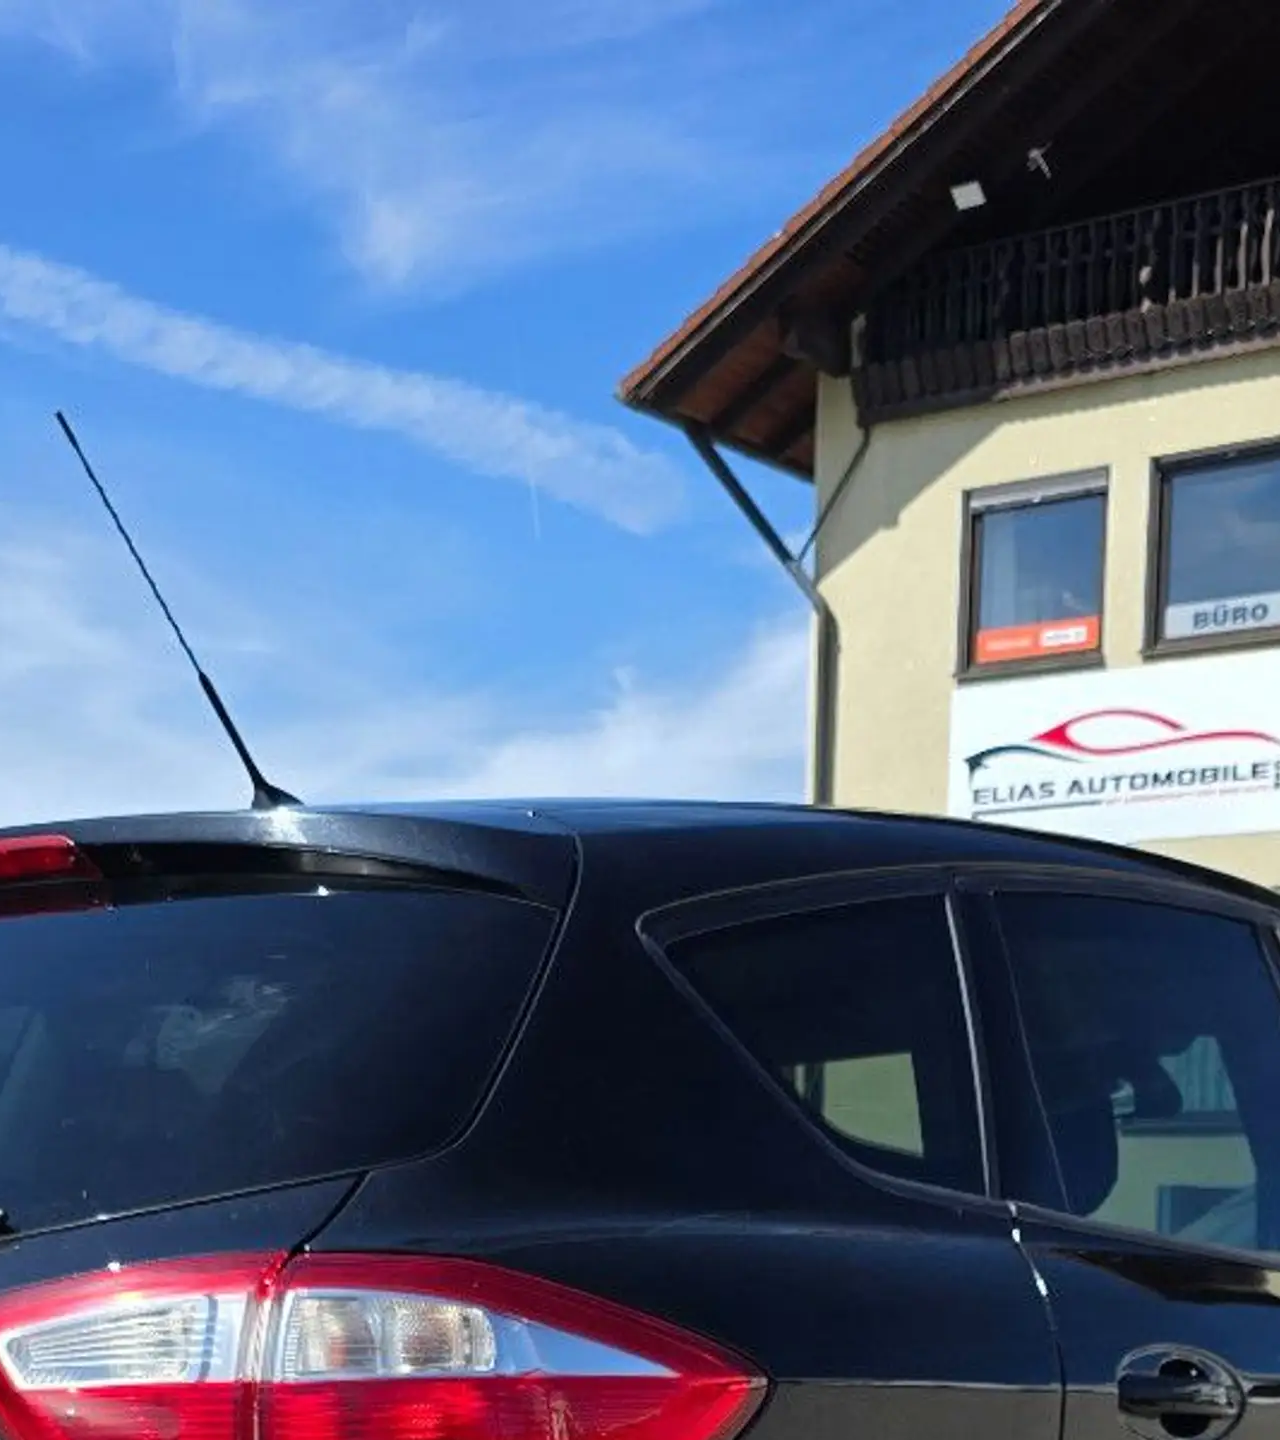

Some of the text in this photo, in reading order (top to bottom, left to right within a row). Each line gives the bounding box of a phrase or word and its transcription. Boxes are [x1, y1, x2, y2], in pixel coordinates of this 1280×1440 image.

[1193, 603, 1269, 629] BÜRO
[972, 782, 1055, 805] ELIAS
[1067, 761, 1271, 796] AUTOMOBILE
